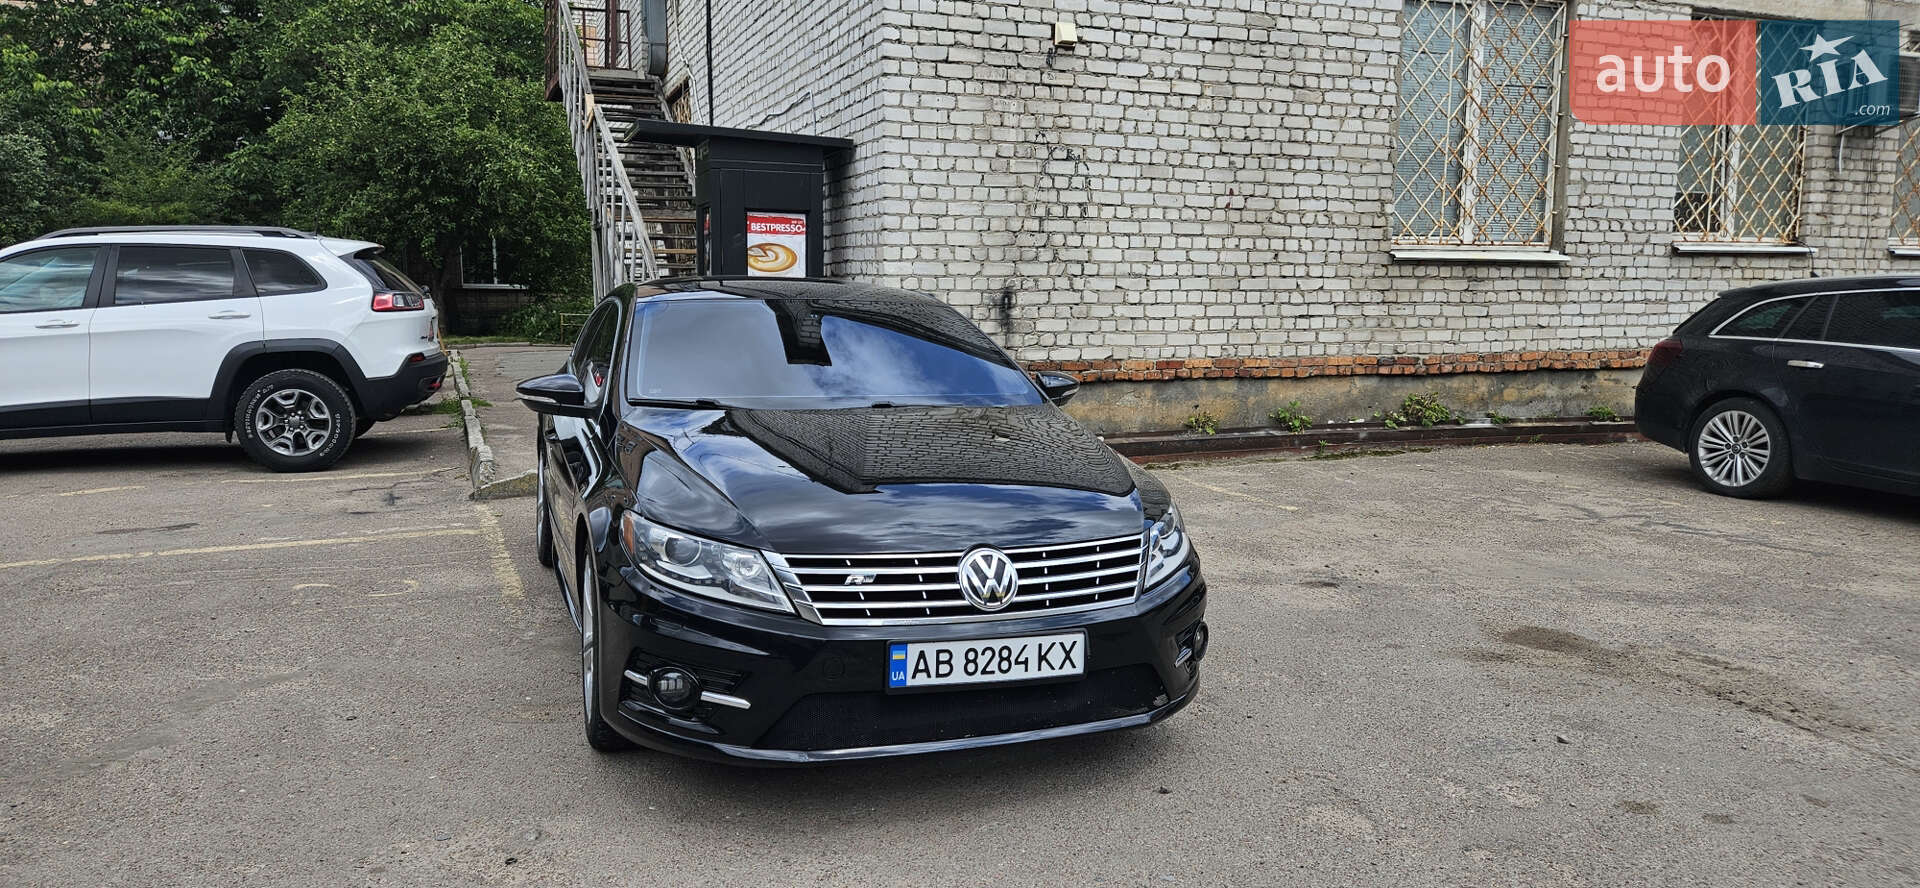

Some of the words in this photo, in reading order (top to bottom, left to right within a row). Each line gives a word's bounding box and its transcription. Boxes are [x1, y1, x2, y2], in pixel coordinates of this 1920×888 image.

[751, 223, 802, 232] BESTPRESSO
[911, 649, 954, 680] AB
[963, 644, 1029, 676] 8284
[1037, 640, 1078, 672] KX
[891, 671, 905, 681] UA
